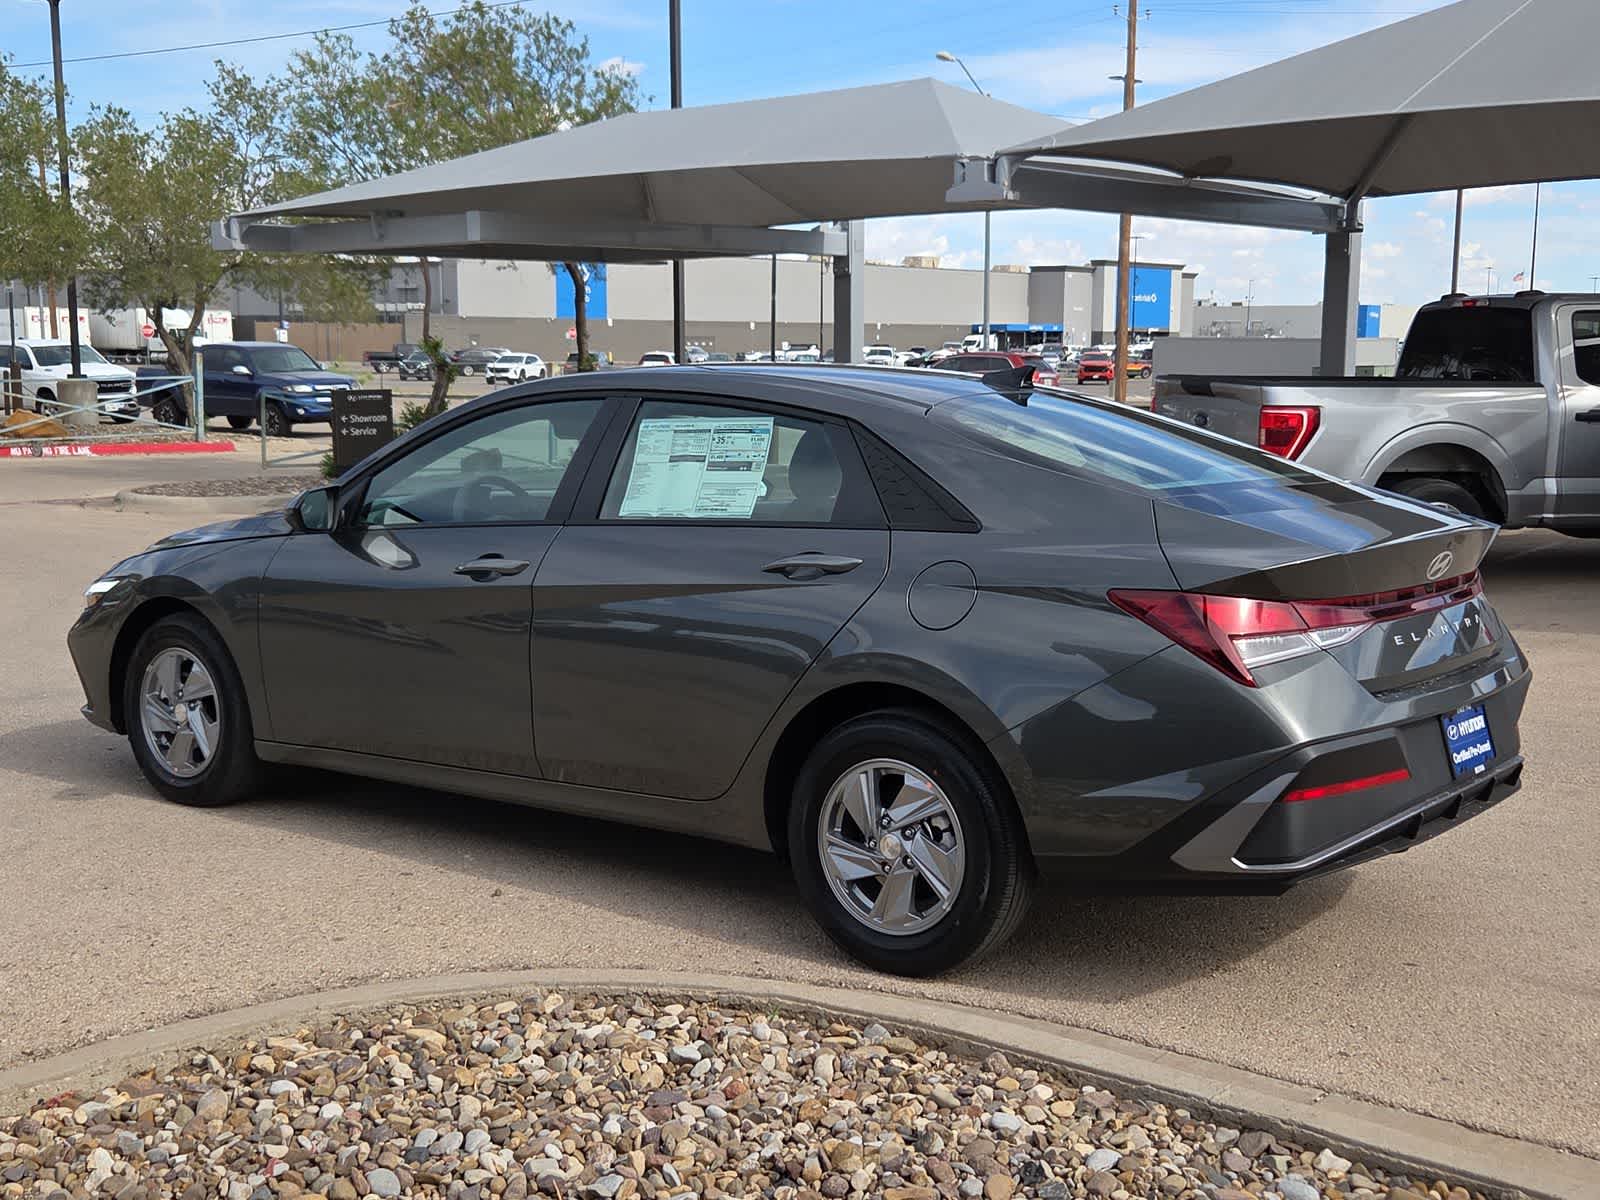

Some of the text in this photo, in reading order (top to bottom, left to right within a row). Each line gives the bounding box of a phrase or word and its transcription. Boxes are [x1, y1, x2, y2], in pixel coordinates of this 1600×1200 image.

[350, 415, 388, 423] Showroom
[350, 427, 377, 436] Service
[10, 447, 22, 456] NO
[54, 446, 71, 456] FIRE
[71, 446, 93, 456] LANE
[1393, 614, 1480, 646] ELANTRA
[1457, 715, 1486, 736] HYUNDAI
